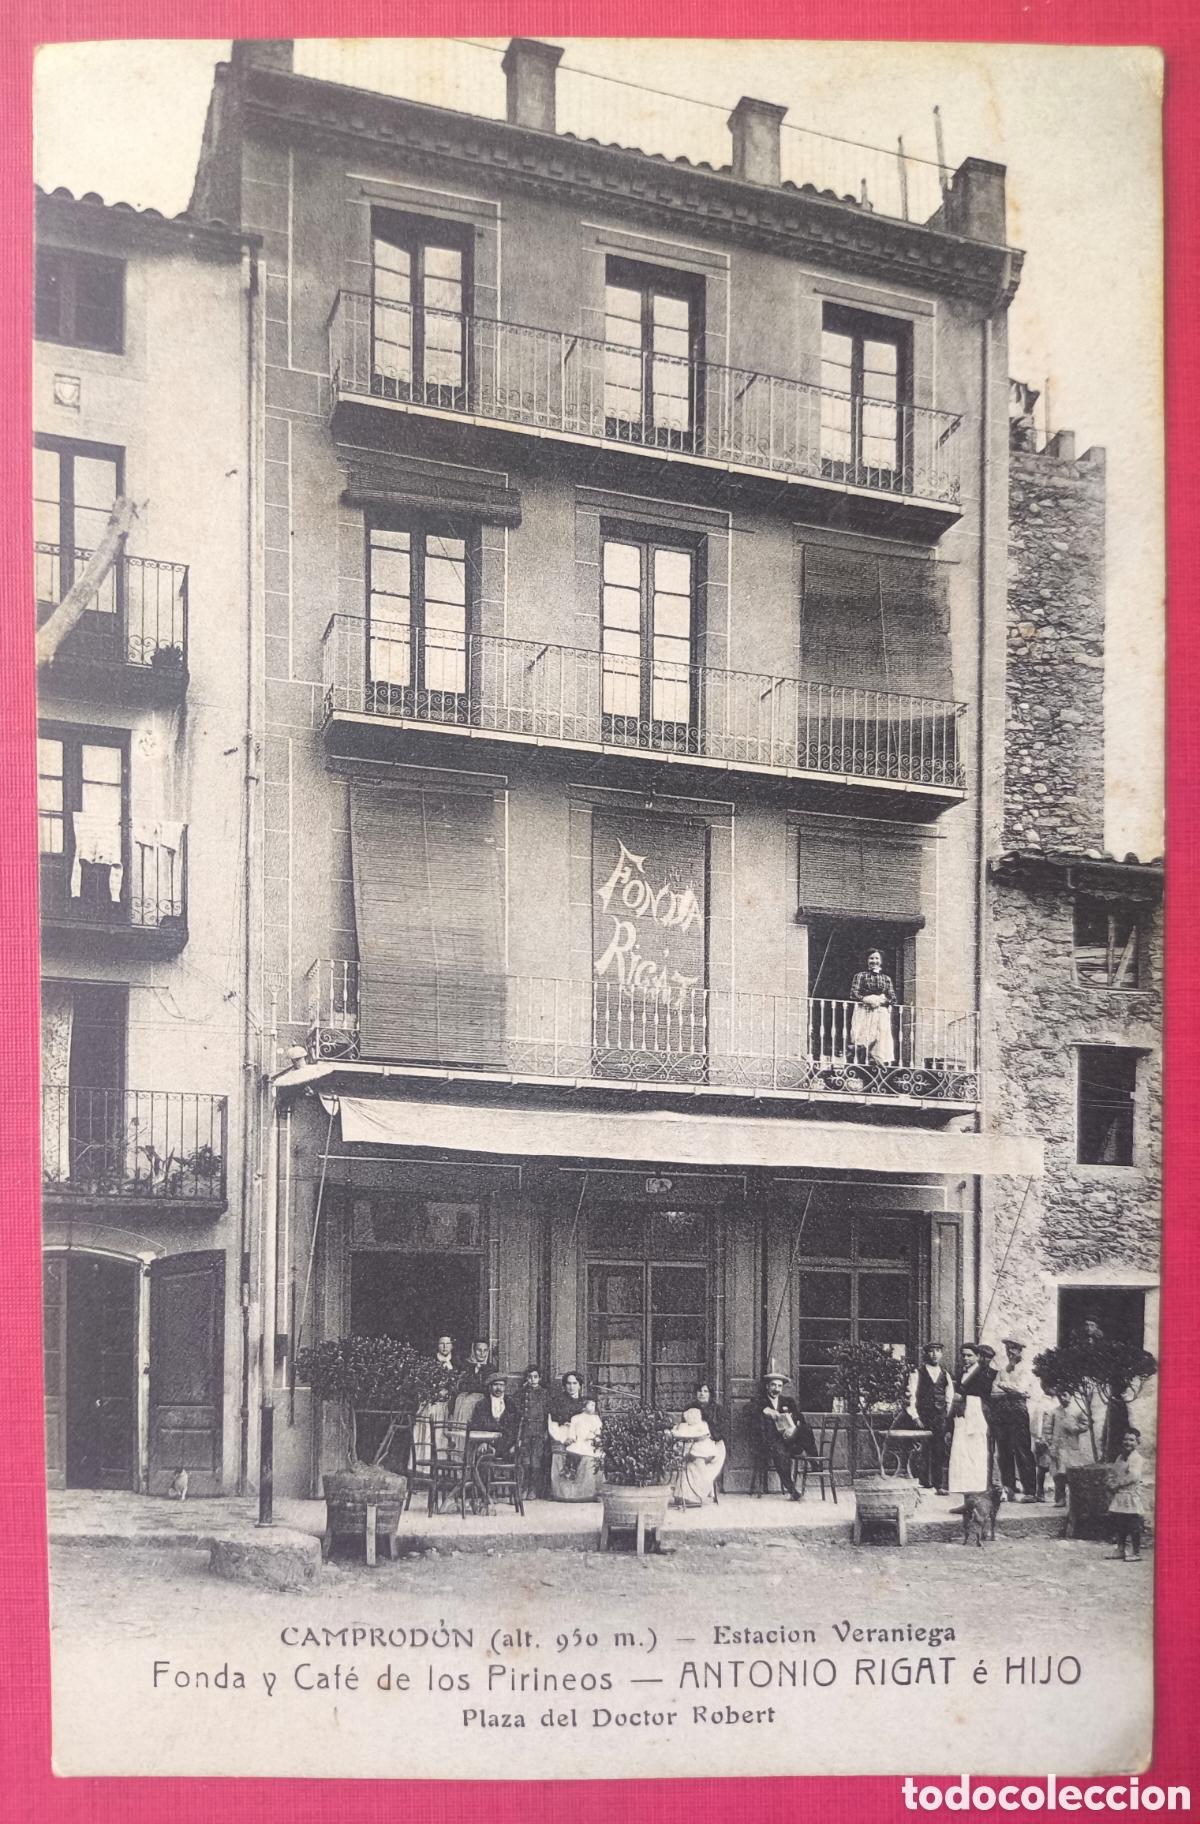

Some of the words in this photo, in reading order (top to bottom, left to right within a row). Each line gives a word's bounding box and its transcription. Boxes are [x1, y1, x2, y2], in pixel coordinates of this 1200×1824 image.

[280, 1618, 474, 1648] CAMPRODÓN
[490, 1627, 540, 1656] (alt.
[556, 1628, 598, 1653] 950
[613, 1626, 658, 1654] m.)
[713, 1624, 817, 1645] Estacion
[831, 1619, 956, 1647] Veraniega
[153, 1660, 246, 1690] Fonda
[262, 1672, 277, 1697] y
[293, 1662, 360, 1692] Café
[376, 1663, 411, 1692] de
[428, 1664, 471, 1692] los
[488, 1664, 613, 1692] Pirineos
[678, 1657, 838, 1689] ANTONIO
[854, 1656, 957, 1686] RIGAT
[972, 1659, 988, 1685] é
[1005, 1655, 1082, 1686] HIJO
[462, 1707, 526, 1729] Plaza
[540, 1707, 578, 1728] del
[592, 1706, 678, 1728] Doctor
[692, 1704, 776, 1725] Robert
